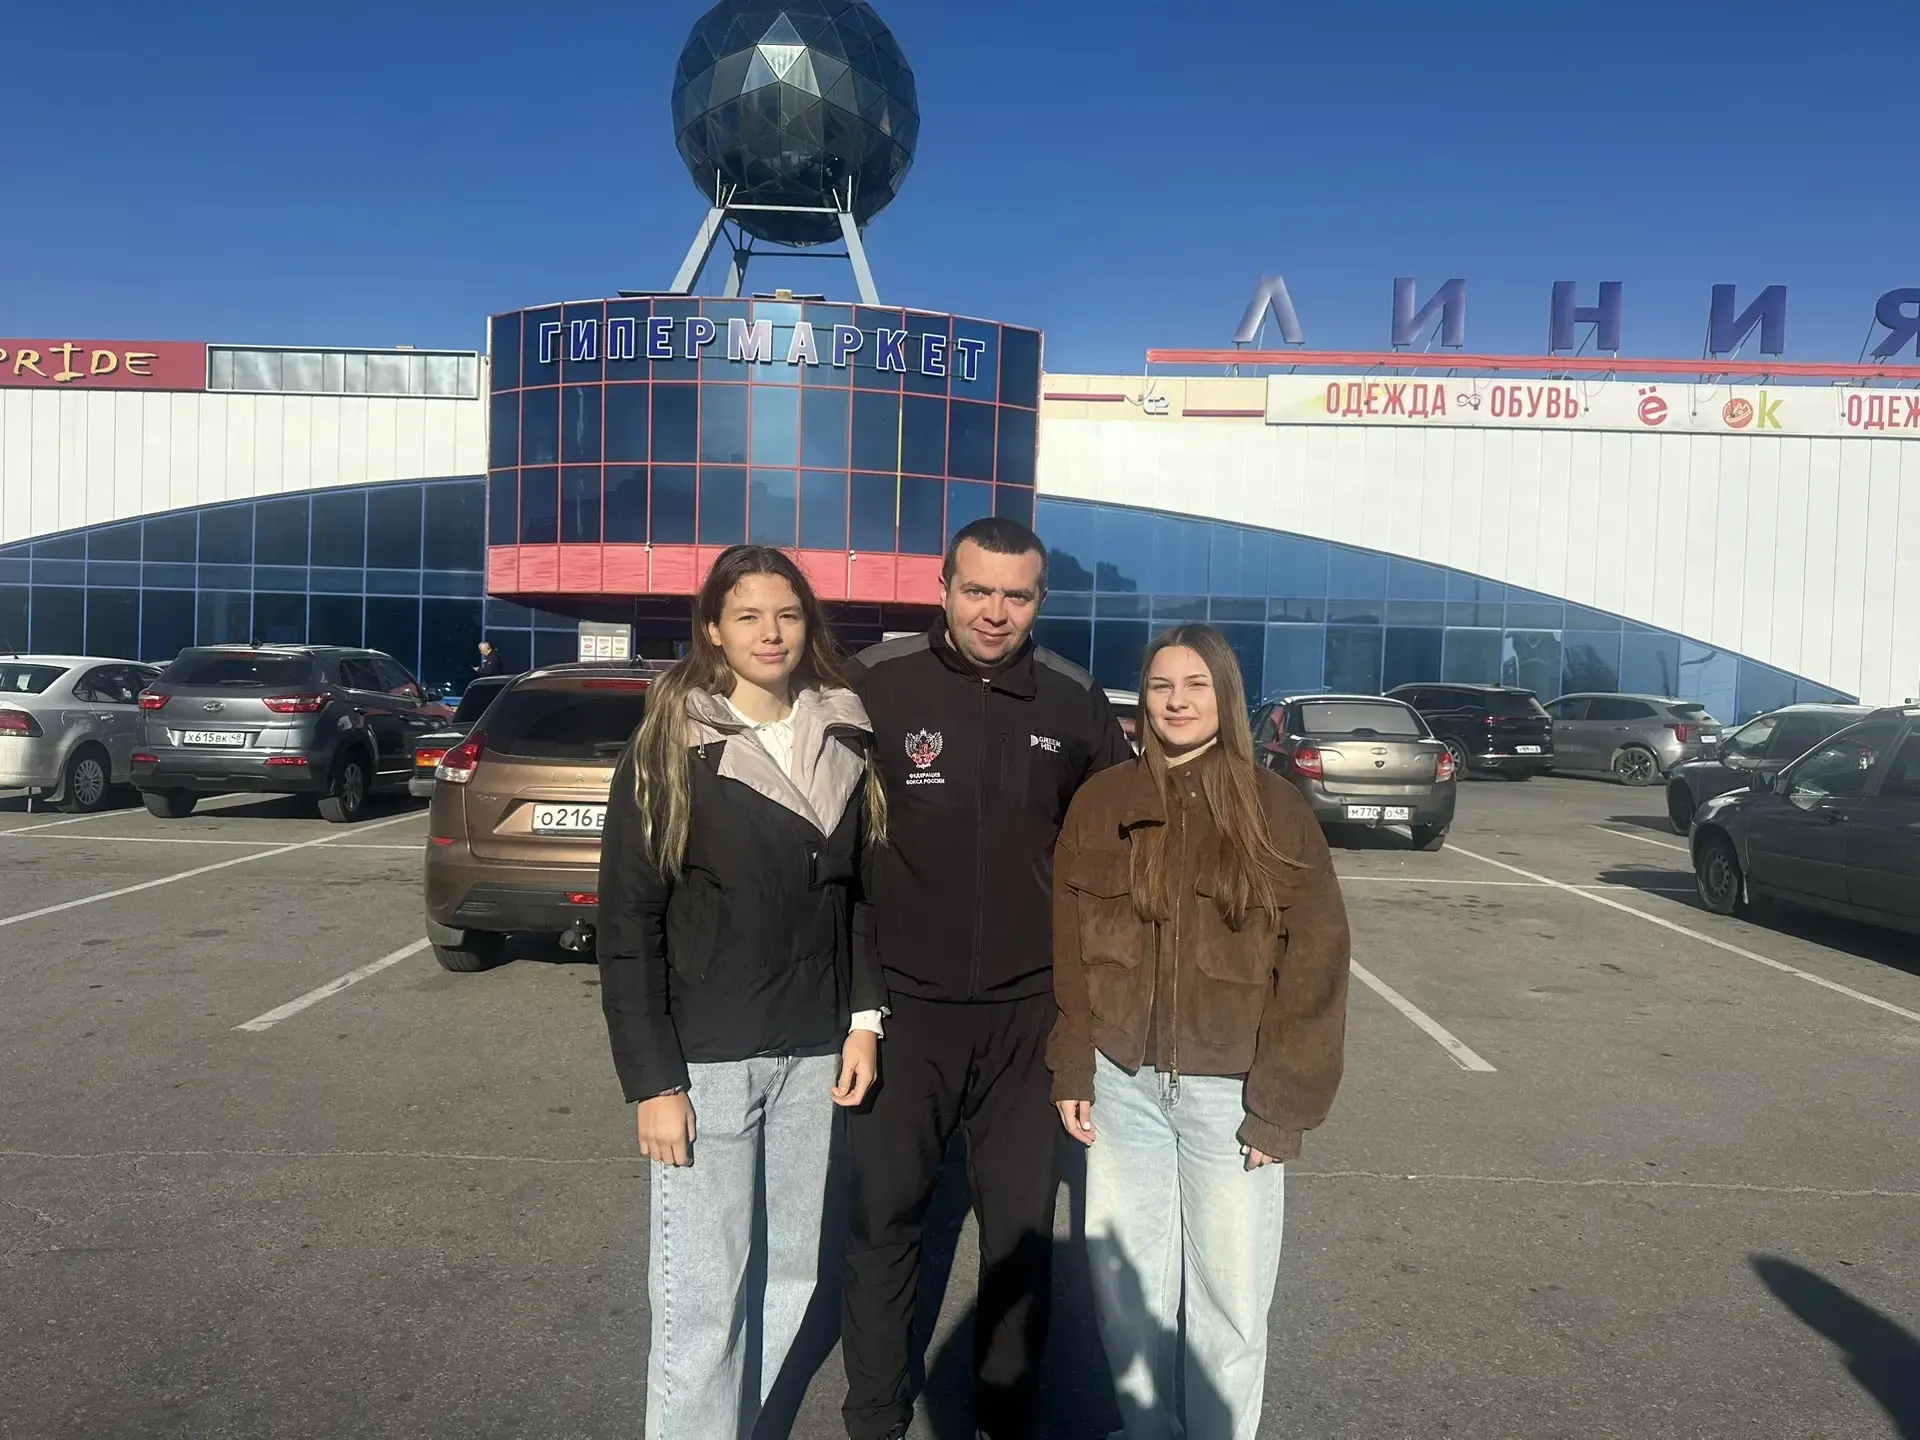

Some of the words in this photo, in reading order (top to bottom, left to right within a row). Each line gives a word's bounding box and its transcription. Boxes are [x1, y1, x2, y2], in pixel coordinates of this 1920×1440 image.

[1232, 275, 1920, 357] ЛИНИЯ
[539, 317, 986, 381] ГИПЕРМАРКЕТ
[1326, 382, 1446, 418] ОДЕЖДА
[1491, 385, 1579, 419] ОБУВЬ
